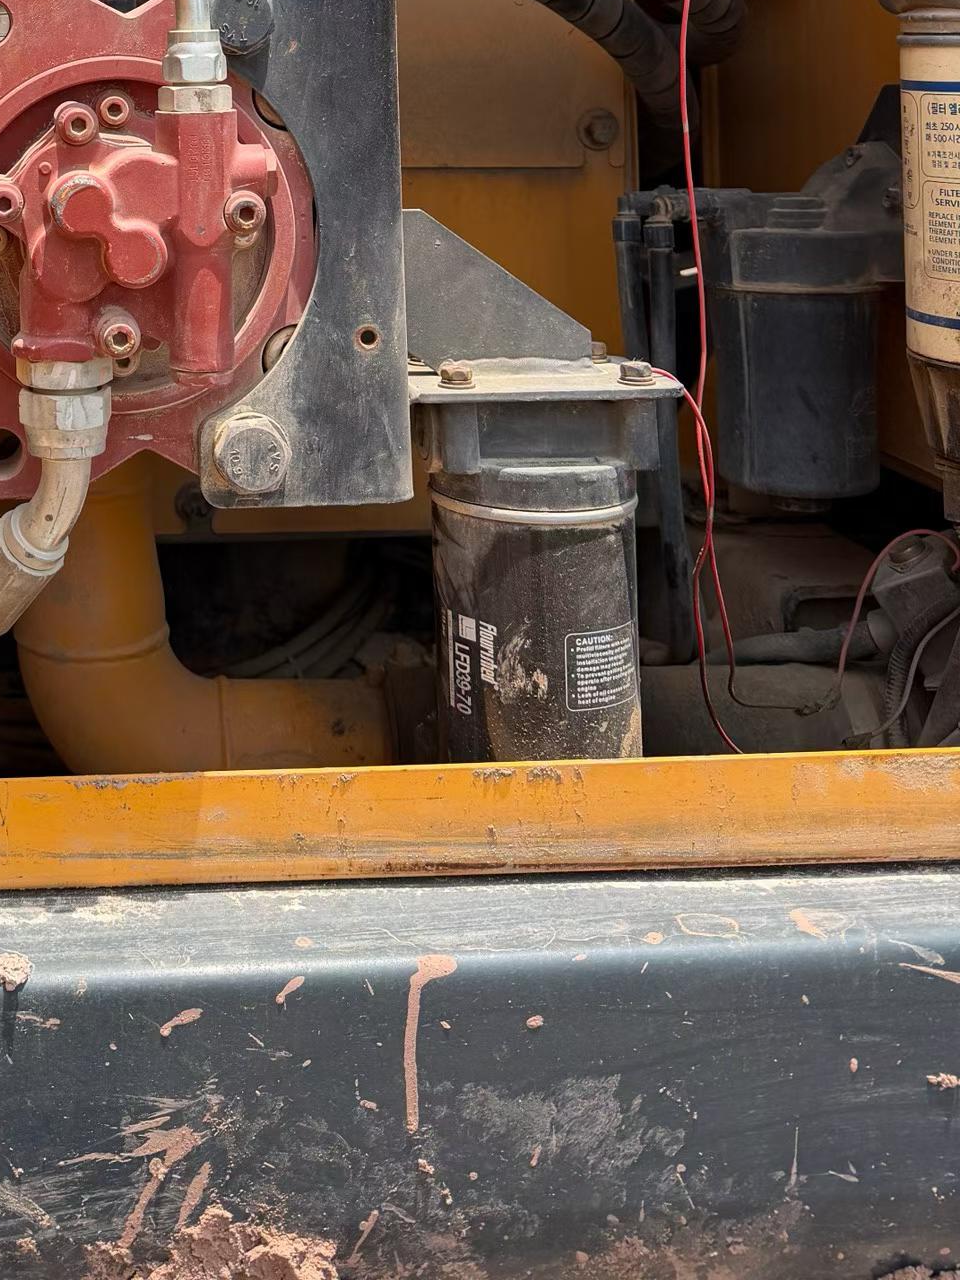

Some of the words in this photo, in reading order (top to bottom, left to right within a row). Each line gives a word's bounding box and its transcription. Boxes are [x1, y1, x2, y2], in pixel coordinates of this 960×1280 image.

[928, 210, 955, 221] REPLACE
[928, 219, 957, 229] ELEMENT
[931, 248, 954, 259] UNDER
[455, 642, 472, 716] LFD39-70
